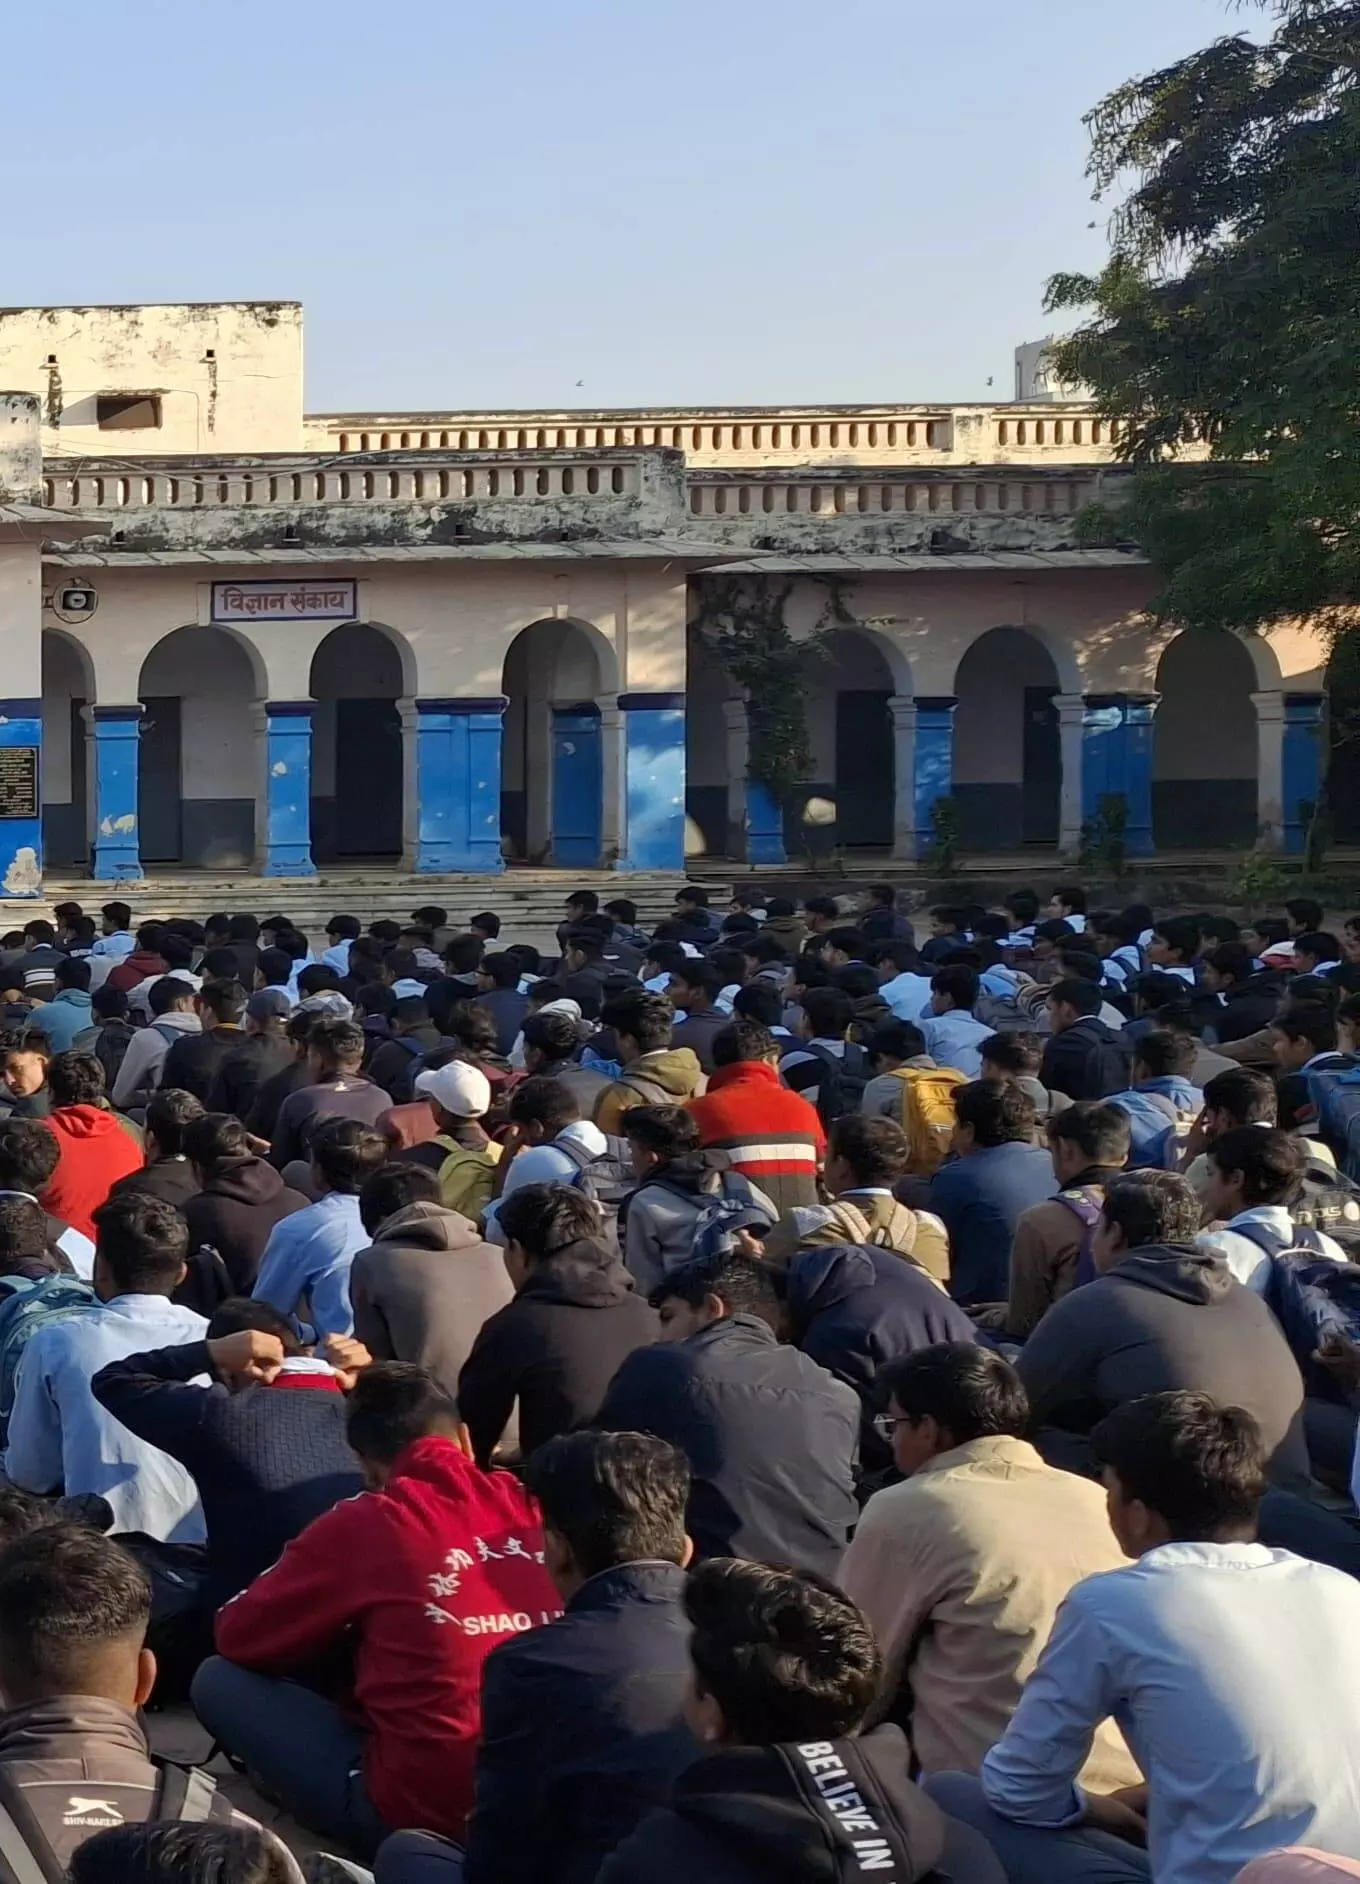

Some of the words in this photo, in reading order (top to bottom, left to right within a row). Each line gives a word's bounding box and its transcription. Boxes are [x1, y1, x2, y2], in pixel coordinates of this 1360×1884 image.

[220, 586, 289, 615] विज्ञान
[290, 586, 349, 613] संकाय
[463, 1612, 533, 1636] SHAO
[797, 1740, 880, 1833] BELIEVE
[851, 1838, 896, 1871] IN
